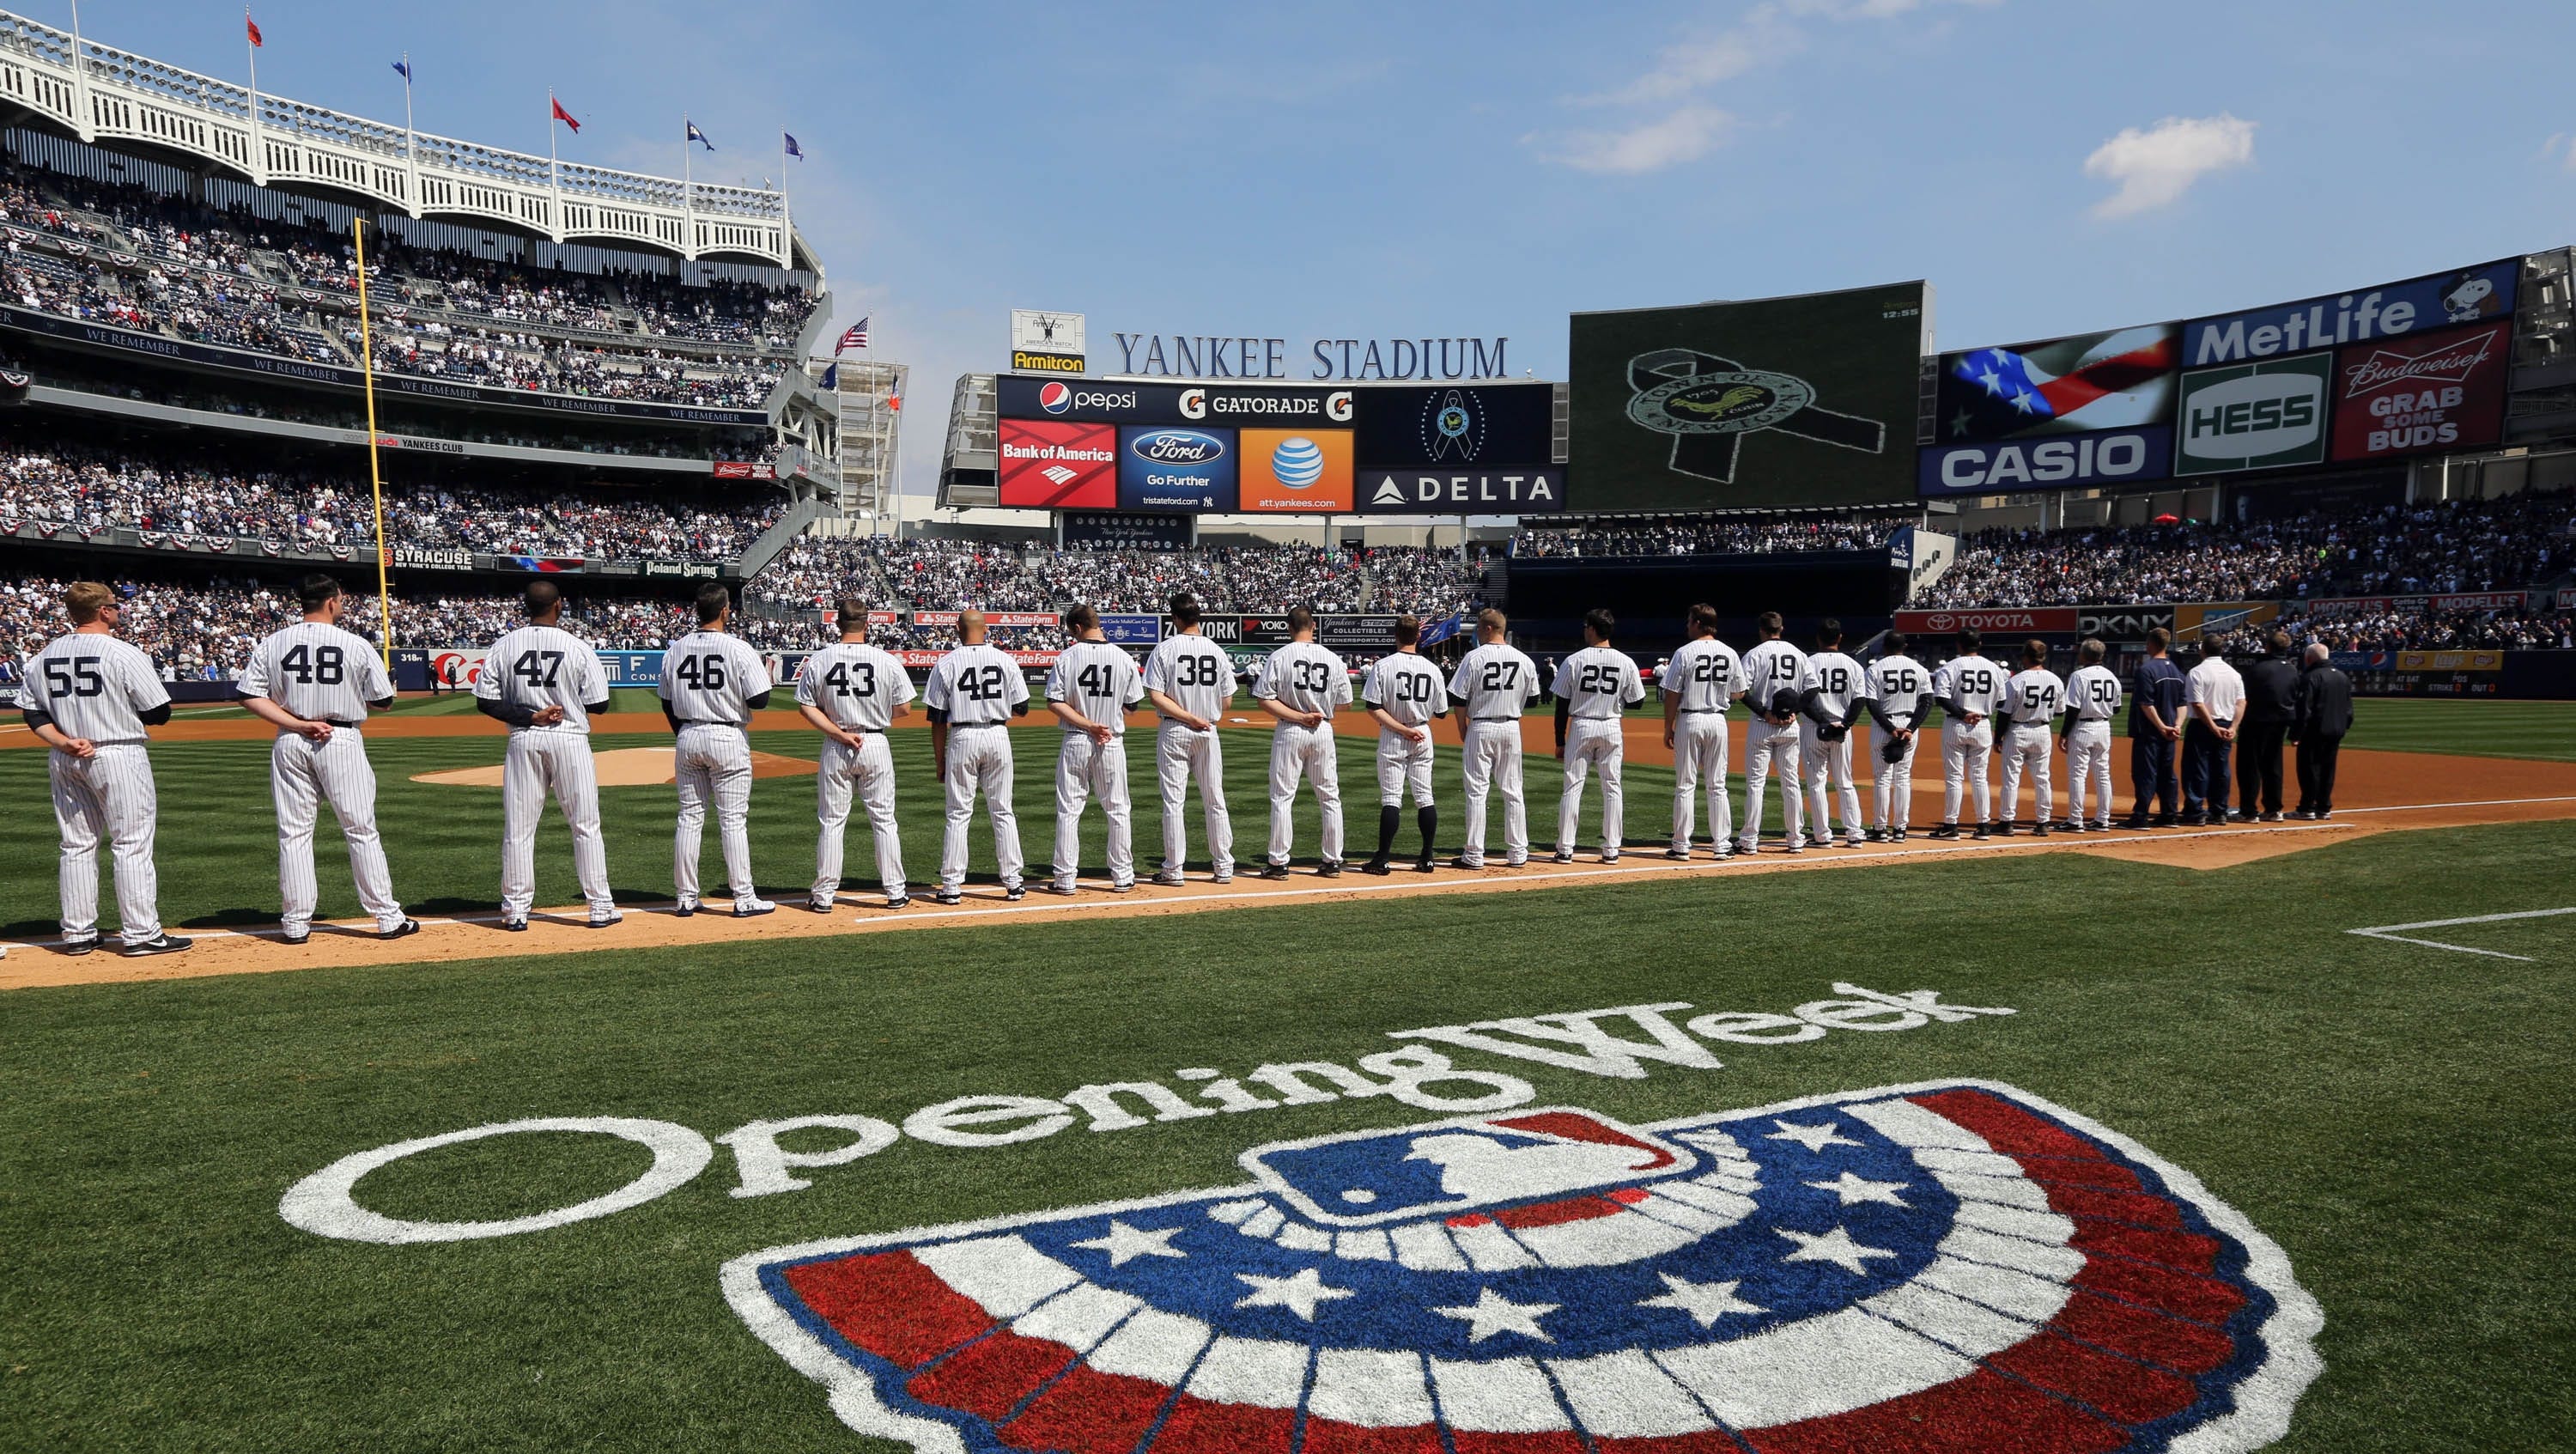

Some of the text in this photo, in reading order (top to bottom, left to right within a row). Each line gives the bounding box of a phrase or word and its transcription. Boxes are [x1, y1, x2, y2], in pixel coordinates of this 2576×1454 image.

[1882, 308, 1918, 319] 12:55
[2196, 292, 2415, 366] MetLife
[85, 328, 181, 356] WE REMEMBER
[1015, 352, 1084, 372] Armitron
[1113, 332, 1510, 380] YANKEE STADIUM
[2346, 350, 2490, 386] Budweiser
[253, 359, 339, 381] WE REMEMBER
[400, 381, 480, 398] WE REMEMBER
[1075, 391, 1137, 411] pepsi
[2369, 386, 2464, 417] GRAB
[542, 398, 617, 413] WE REMEMBER
[670, 409, 740, 422] WE REMEMBER
[1212, 398, 1319, 415] GATORADE
[2190, 393, 2314, 439] HESS
[2383, 409, 2445, 429] SOME
[402, 439, 440, 451] YANKEES
[442, 443, 464, 453] CLUB
[1150, 435, 1206, 460] Ford
[2367, 422, 2458, 452] BUDS
[1003, 443, 1114, 462] Bank of America
[1941, 435, 2146, 488] CASIO
[1147, 475, 1210, 487] Go Further
[1419, 476, 1553, 502] DELTA
[1143, 496, 1199, 505] tristateford.com
[1259, 498, 1336, 508] att.yankees.com
[395, 550, 472, 565] SYRACUSE
[646, 561, 718, 579] Poland Spring
[2437, 594, 2520, 610] MODELL'S
[1323, 617, 1357, 630] Yankees
[1958, 613, 2034, 629] TOYOTA
[2079, 613, 2173, 635] DKNY
[44, 656, 102, 698] 55
[281, 645, 344, 685] 48
[514, 650, 565, 688] 47
[677, 654, 725, 690] 46
[1177, 654, 1217, 686] 38
[1293, 660, 1329, 693] 33
[1483, 661, 1520, 691] 27
[1695, 654, 1729, 683] 22
[1769, 654, 1796, 681] 19
[825, 662, 875, 697] 43
[957, 666, 1002, 701] 42
[1078, 664, 1113, 697] 41
[1395, 672, 1431, 703] 30
[1580, 665, 1620, 696] 25
[1820, 668, 1848, 694] 18
[1882, 669, 1917, 694] 56
[1960, 670, 1992, 694] 59
[2091, 679, 2115, 703] 50
[2024, 685, 2055, 709] 54
